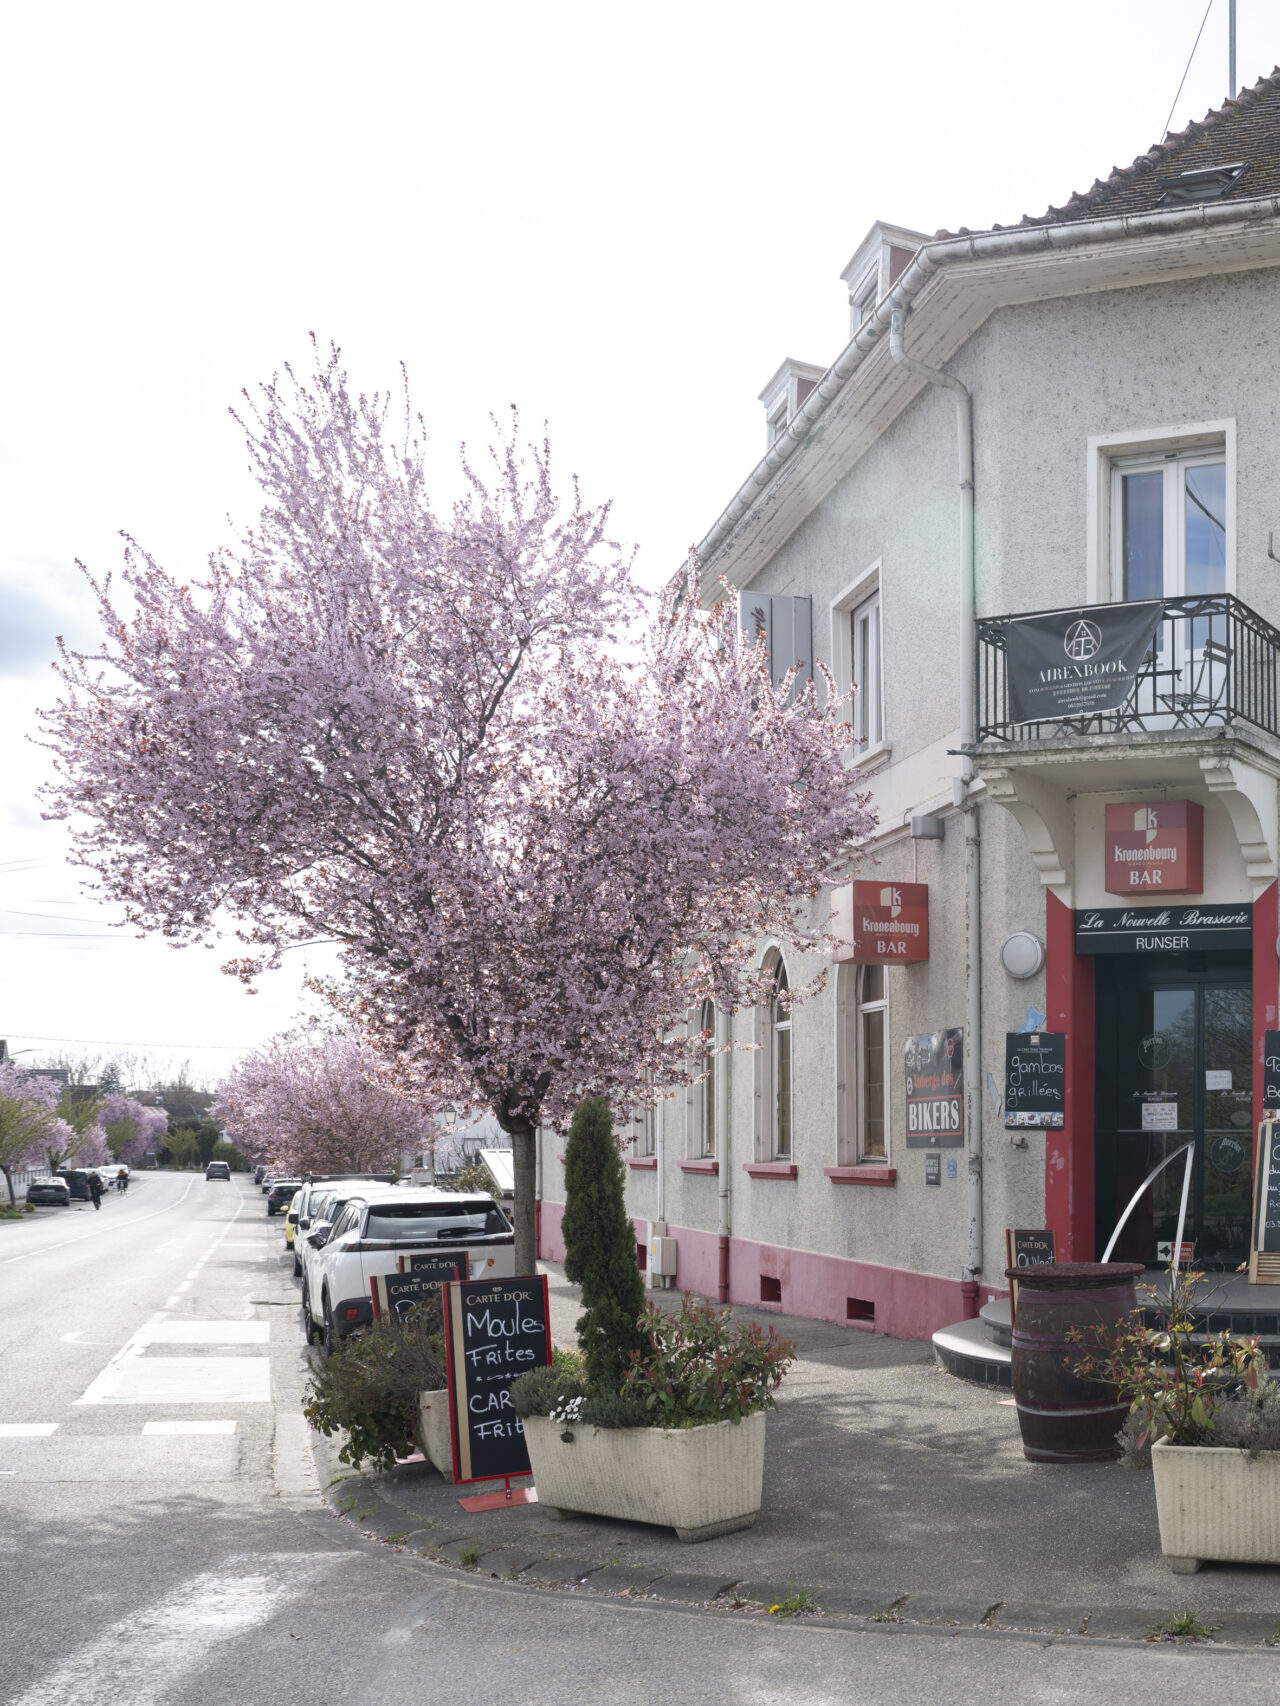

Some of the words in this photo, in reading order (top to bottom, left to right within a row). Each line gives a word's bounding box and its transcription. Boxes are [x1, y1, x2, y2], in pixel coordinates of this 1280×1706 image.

[1114, 845, 1177, 864] Kronenbourg
[1129, 869, 1162, 886] BAR
[862, 916, 920, 937] Kronenbourg
[1079, 912, 1105, 929] La
[1113, 910, 1172, 928] Nouvelle
[1179, 909, 1249, 926] Brasserie
[877, 940, 907, 954] BAR
[1136, 936, 1189, 950] RUNSER
[908, 1100, 960, 1131] BIKERS
[414, 1263, 437, 1271] CARTE
[390, 1283, 420, 1295] CARTE
[466, 1293, 501, 1306] CARTE
[503, 1290, 532, 1302] D'OR
[467, 1301, 545, 1337] Moules
[469, 1390, 515, 1413] CAR
